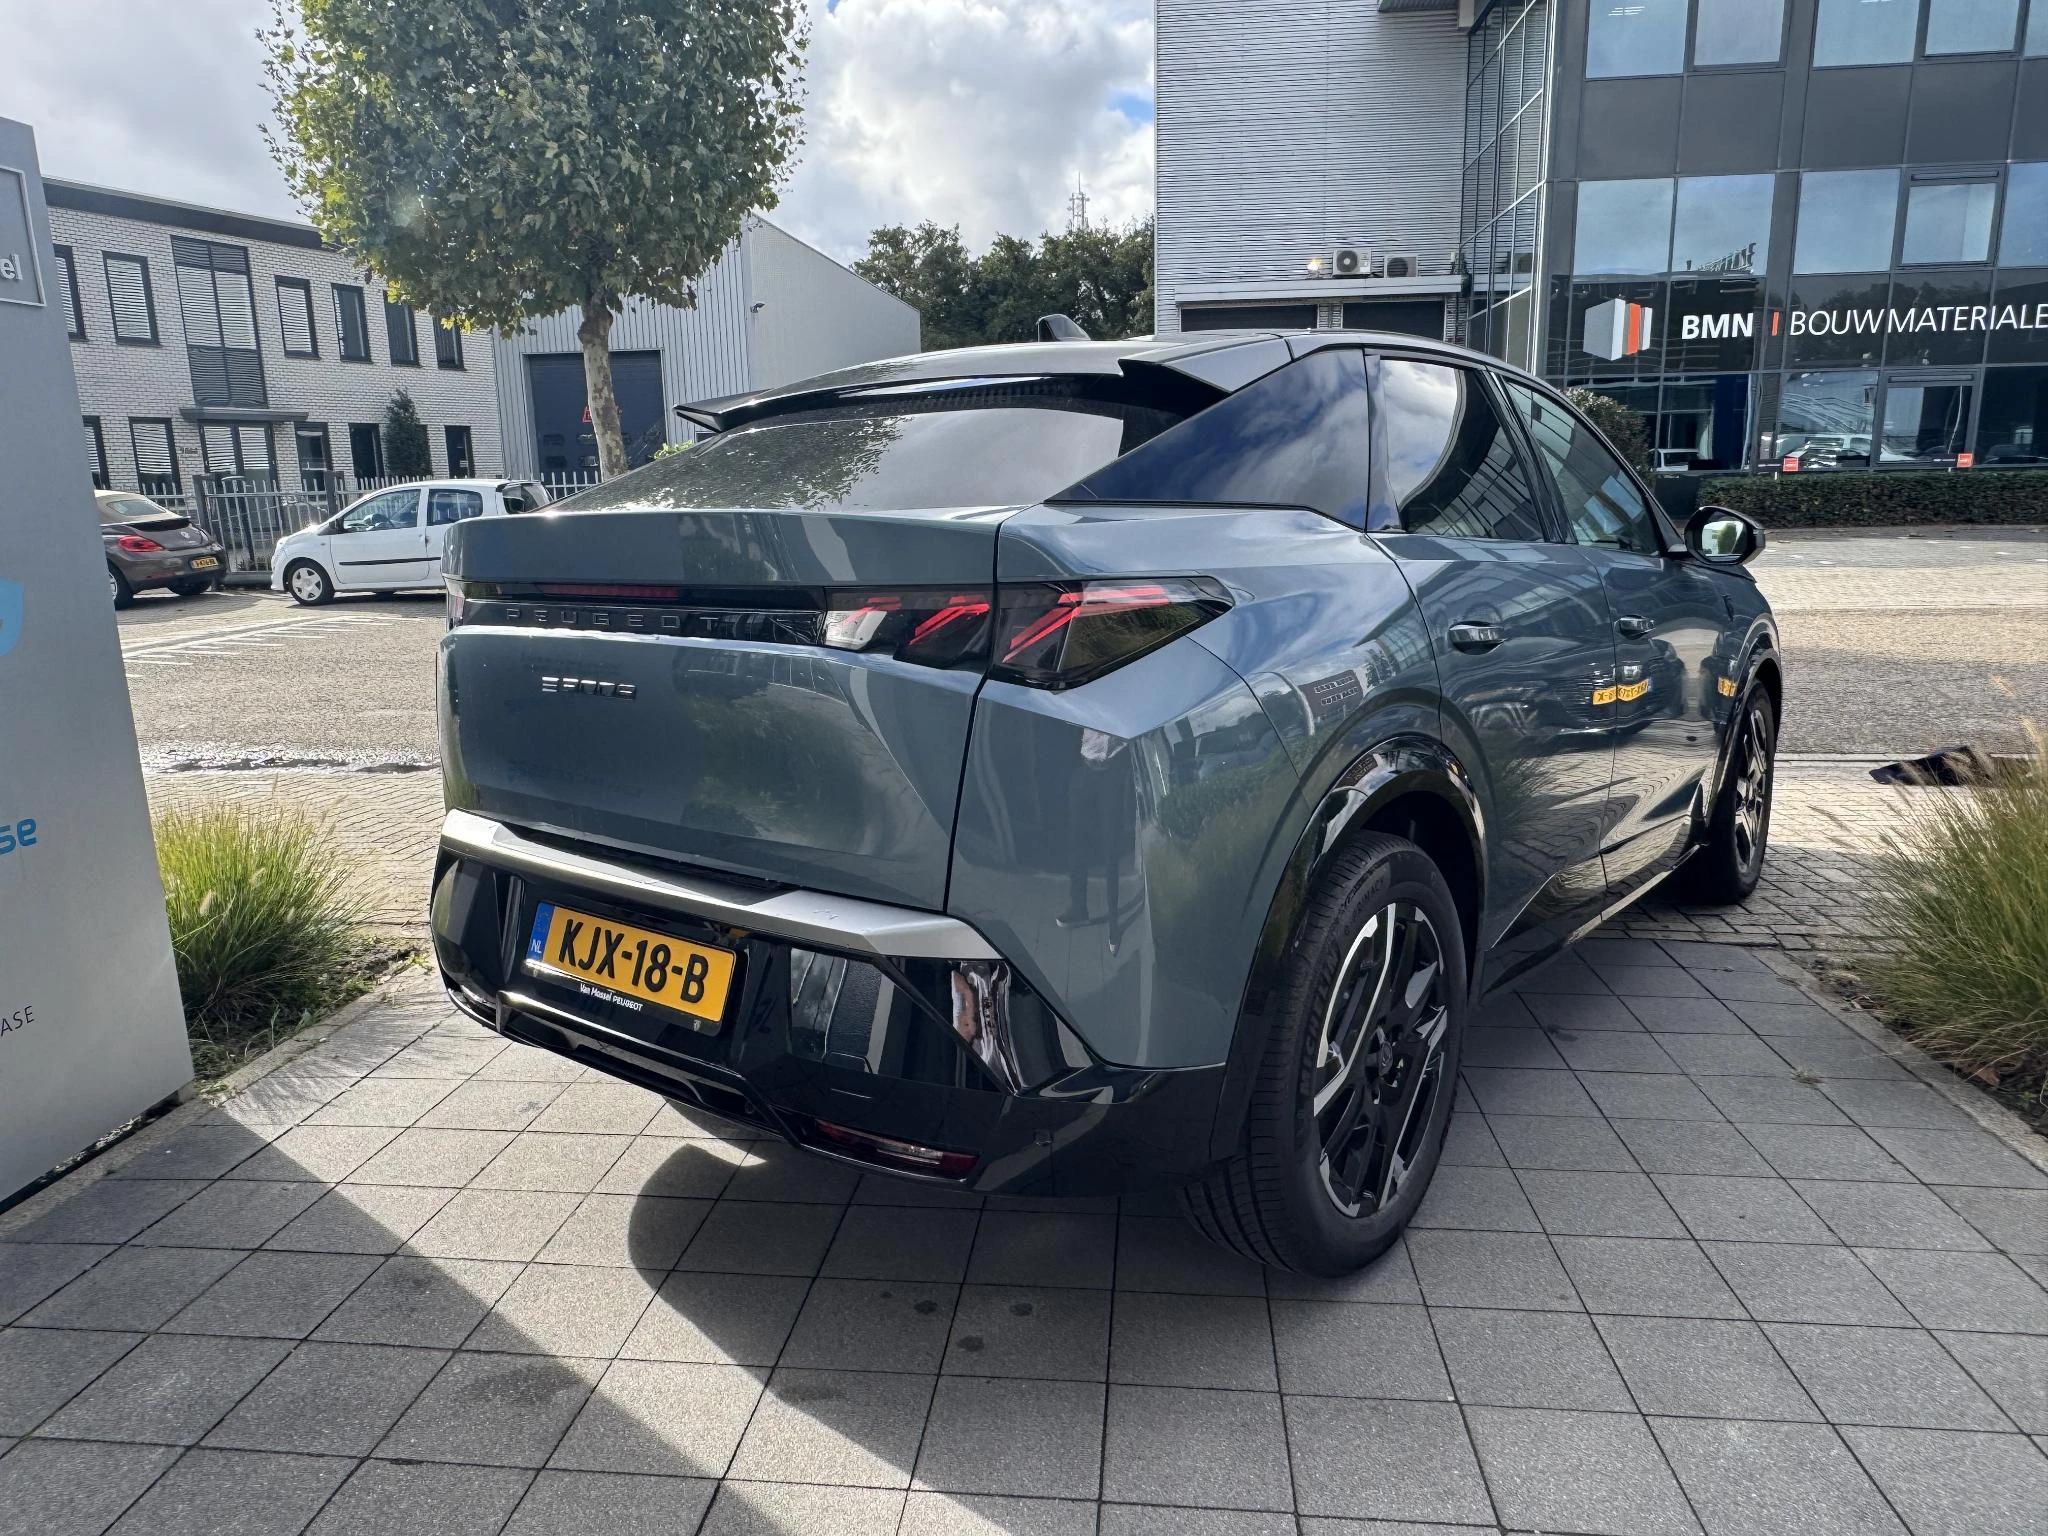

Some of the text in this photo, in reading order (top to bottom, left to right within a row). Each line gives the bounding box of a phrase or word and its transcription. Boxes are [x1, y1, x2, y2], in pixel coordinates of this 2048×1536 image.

[1681, 312, 1754, 340] BMN
[506, 608, 718, 631] PEUGEOT
[530, 938, 543, 954] NL
[558, 918, 710, 1004] KJX-18-B
[580, 983, 591, 995] Van
[612, 995, 643, 1011] PEUGEOT
